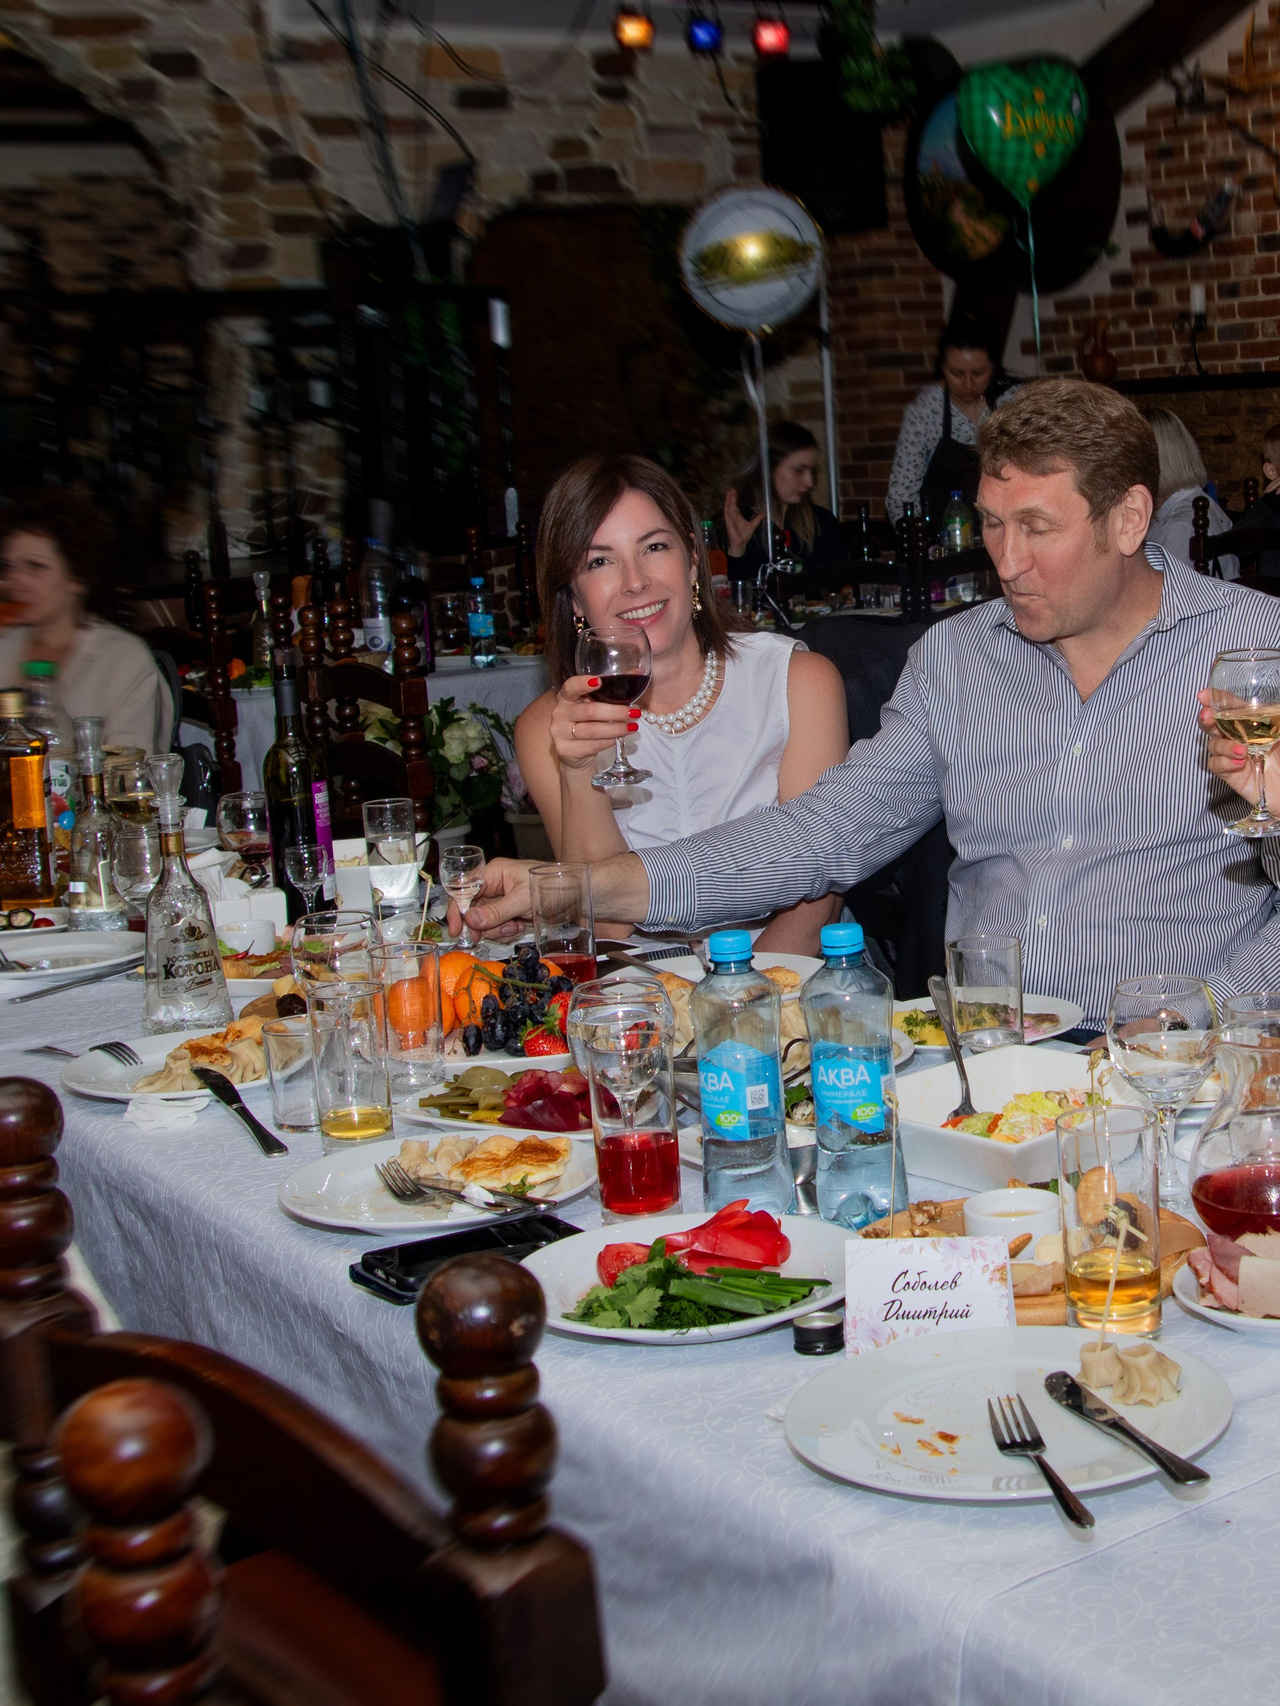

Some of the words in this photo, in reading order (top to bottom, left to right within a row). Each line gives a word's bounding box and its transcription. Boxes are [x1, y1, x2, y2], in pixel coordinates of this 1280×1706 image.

[162, 956, 221, 980] КОРОНА
[700, 1071, 735, 1093] КВА
[817, 1064, 871, 1089] АКВА
[891, 1269, 963, 1294] Соболев
[882, 1298, 975, 1326] Дмитрий
